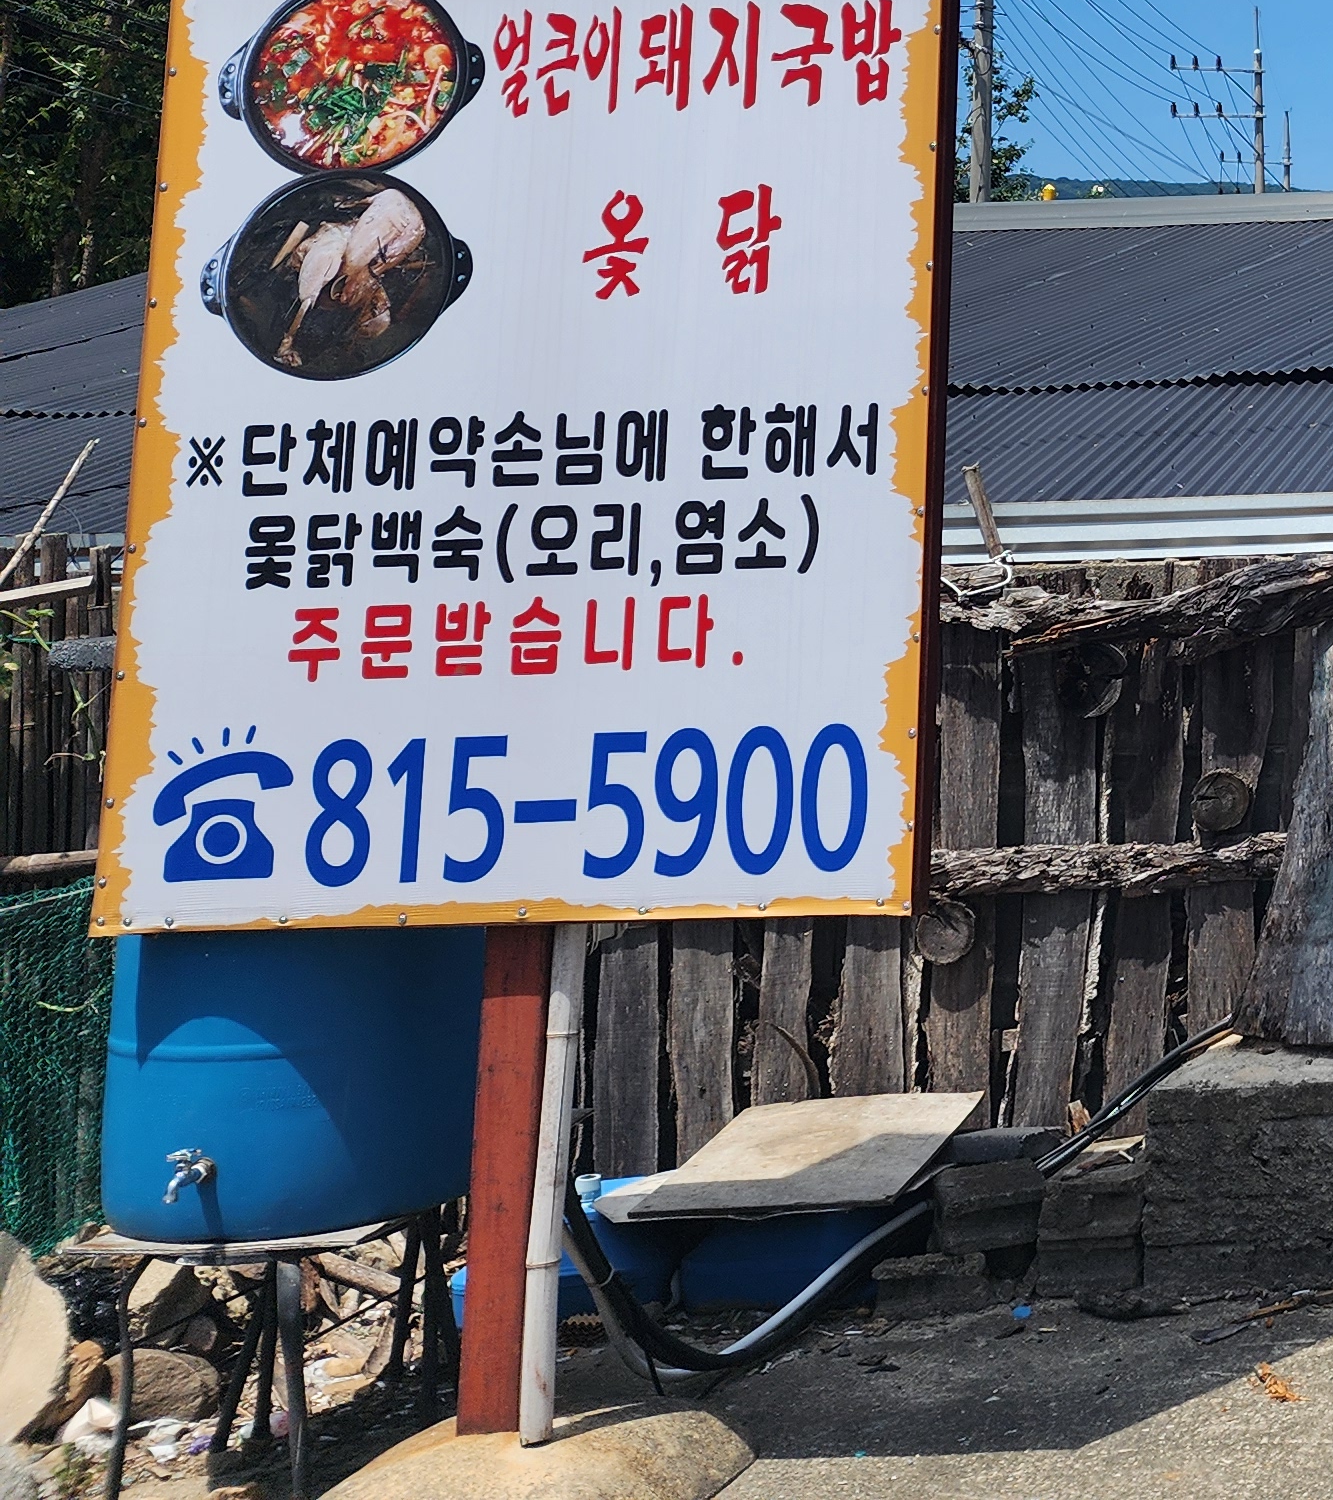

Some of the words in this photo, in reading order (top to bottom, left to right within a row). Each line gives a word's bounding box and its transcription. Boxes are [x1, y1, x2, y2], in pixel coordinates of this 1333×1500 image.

[700, 401, 880, 482] 한해서
[288, 593, 744, 683] 주문받습니다.
[303, 722, 869, 889] 815-5900
